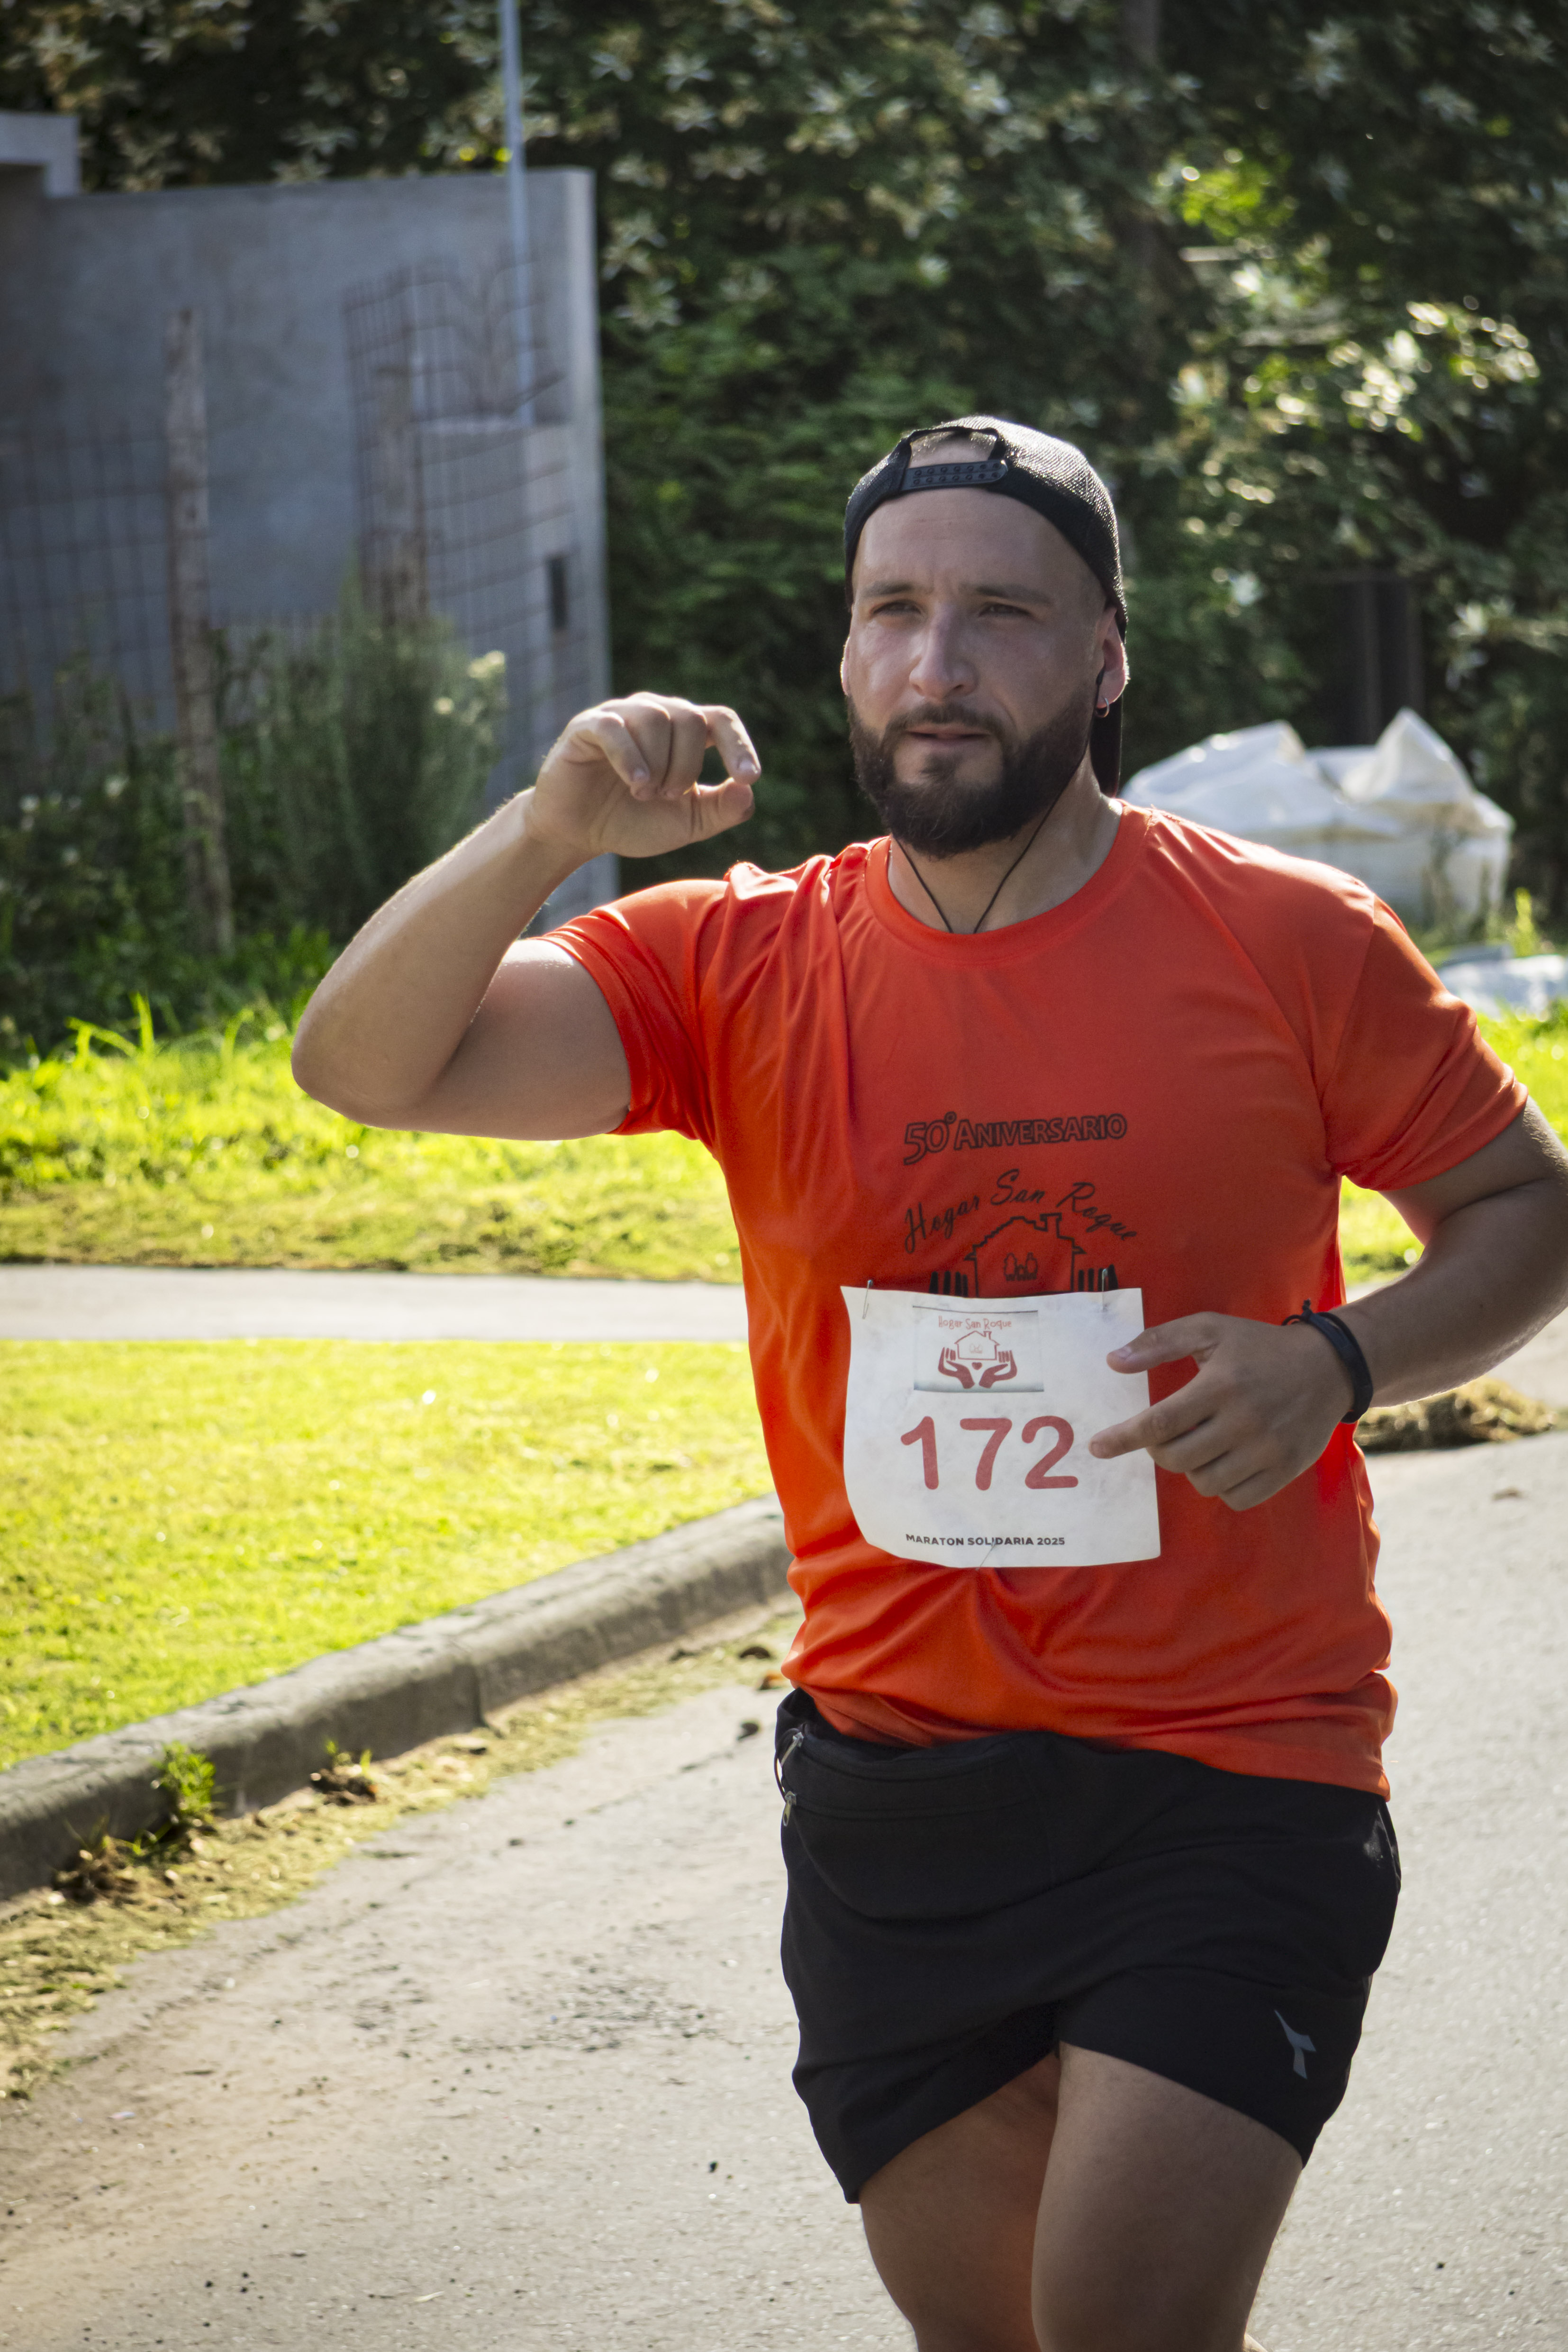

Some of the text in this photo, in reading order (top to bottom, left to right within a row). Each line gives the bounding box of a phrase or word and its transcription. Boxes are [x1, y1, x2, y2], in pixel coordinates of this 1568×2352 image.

[953, 1114, 1127, 1150] ANIVERSARIO
[905, 1195, 979, 1253] Hogar
[990, 1168, 1045, 1206] San
[938, 1316, 1012, 1330] Hogar San Roque
[901, 1416, 1079, 1490] 172
[906, 1534, 1065, 1546] MARATON SOLIDARIA 2025
